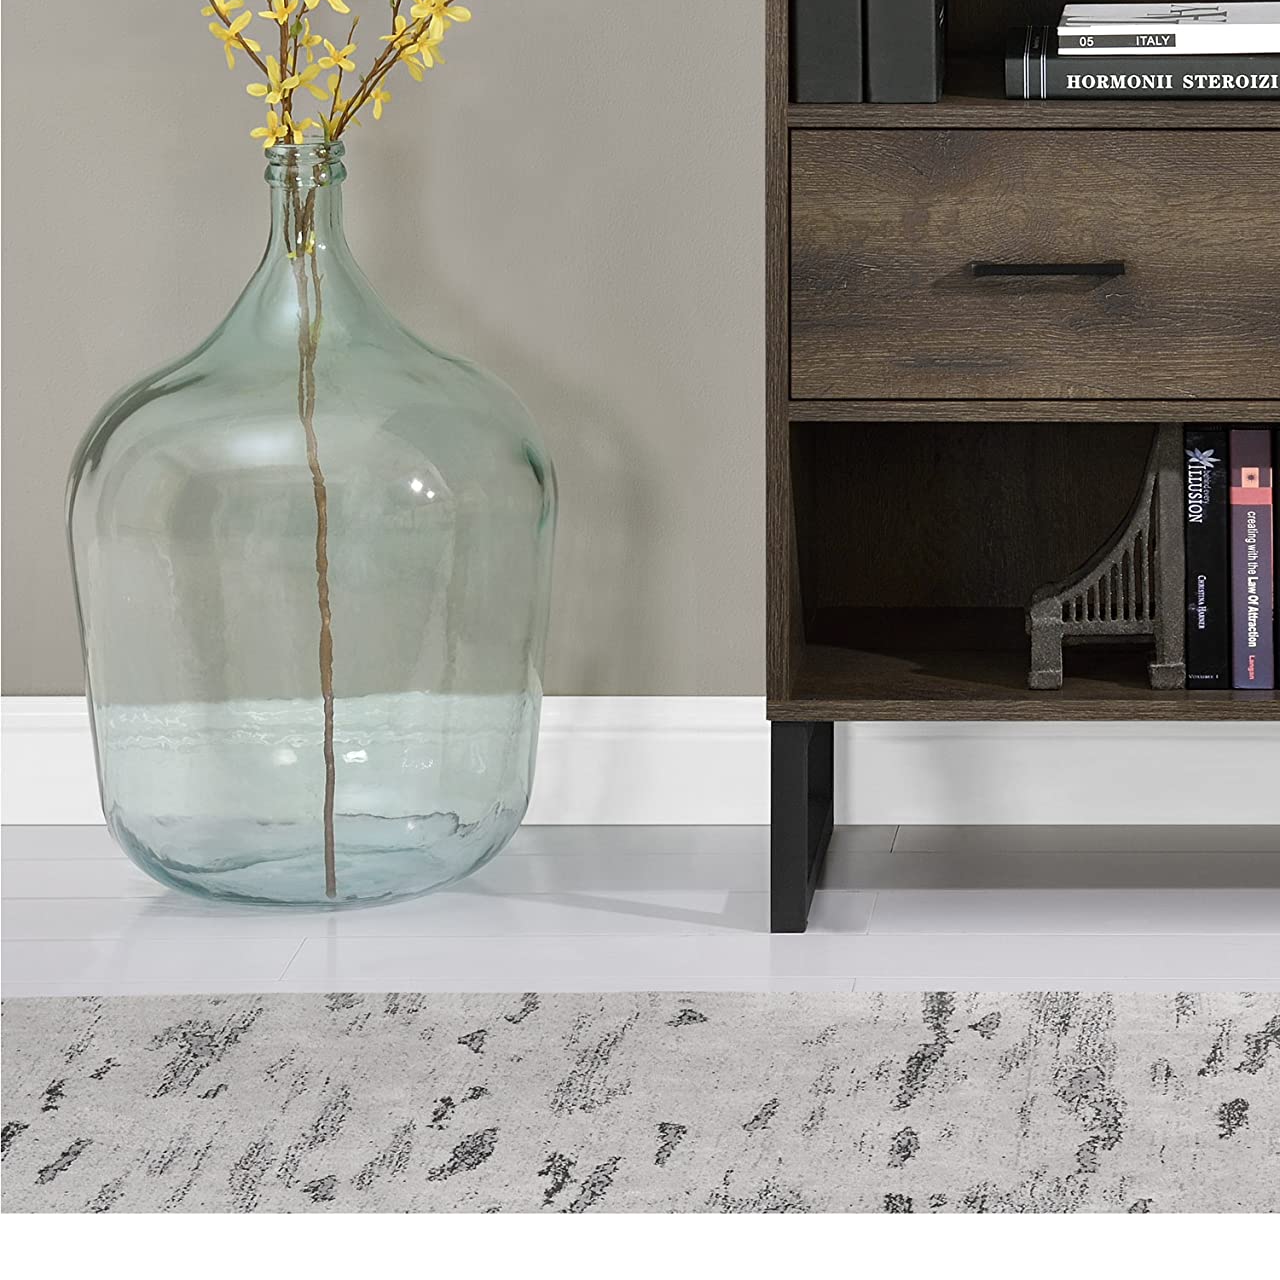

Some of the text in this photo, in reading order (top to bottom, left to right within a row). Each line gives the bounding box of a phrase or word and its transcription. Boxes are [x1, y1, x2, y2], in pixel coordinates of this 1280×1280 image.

[1079, 35, 1171, 47] 05 ITALY
[1066, 74, 1173, 89] HORMONII
[1182, 74, 1279, 89] STEROIZI
[1188, 464, 1207, 523] ILLUSION
[1245, 510, 1258, 543] creating
[1247, 544, 1258, 560] with
[1247, 562, 1258, 575] the
[1247, 576, 1258, 594] Law
[1248, 594, 1259, 606] Of
[1248, 606, 1259, 648] Attraction
